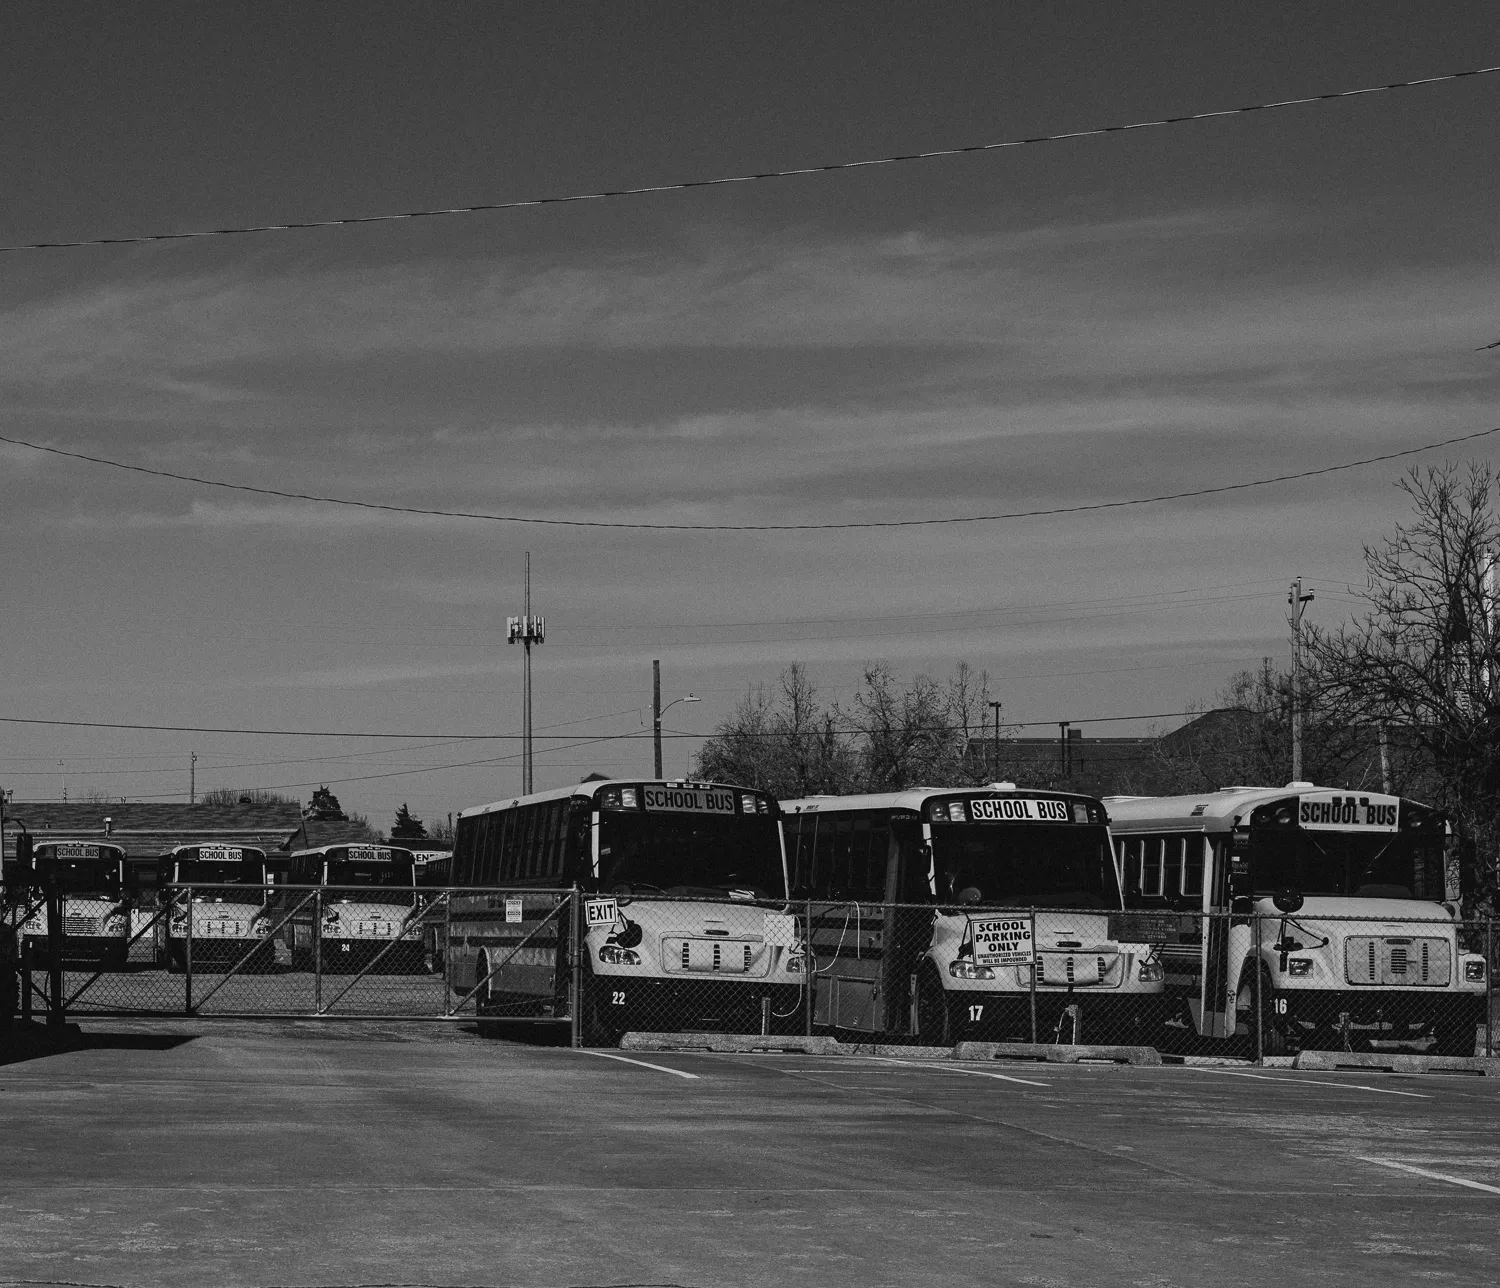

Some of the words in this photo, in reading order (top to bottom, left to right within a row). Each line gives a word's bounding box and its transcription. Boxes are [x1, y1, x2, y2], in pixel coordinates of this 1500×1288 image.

[645, 790, 703, 809] SCHOOL
[705, 793, 734, 811] BUS
[972, 801, 1033, 819] SCHOOL
[1036, 801, 1067, 820] BUS
[1300, 802, 1360, 824] SCHOOL
[1366, 804, 1397, 826] BUS
[57, 848, 84, 857] SCHOOL
[85, 849, 99, 857] BUS
[200, 851, 227, 860] SCHOOL
[228, 851, 242, 860] BUS
[349, 850, 376, 860] SCHOOL
[377, 851, 391, 861] BUS
[589, 904, 614, 921] EXIT
[979, 921, 1026, 932] SCHOOL
[975, 931, 1031, 943] PARKING
[341, 943, 350, 952] 24
[988, 942, 1019, 952] ONLY
[612, 991, 626, 1005] 22
[968, 1005, 984, 1021] 17
[1274, 998, 1288, 1015] 16
